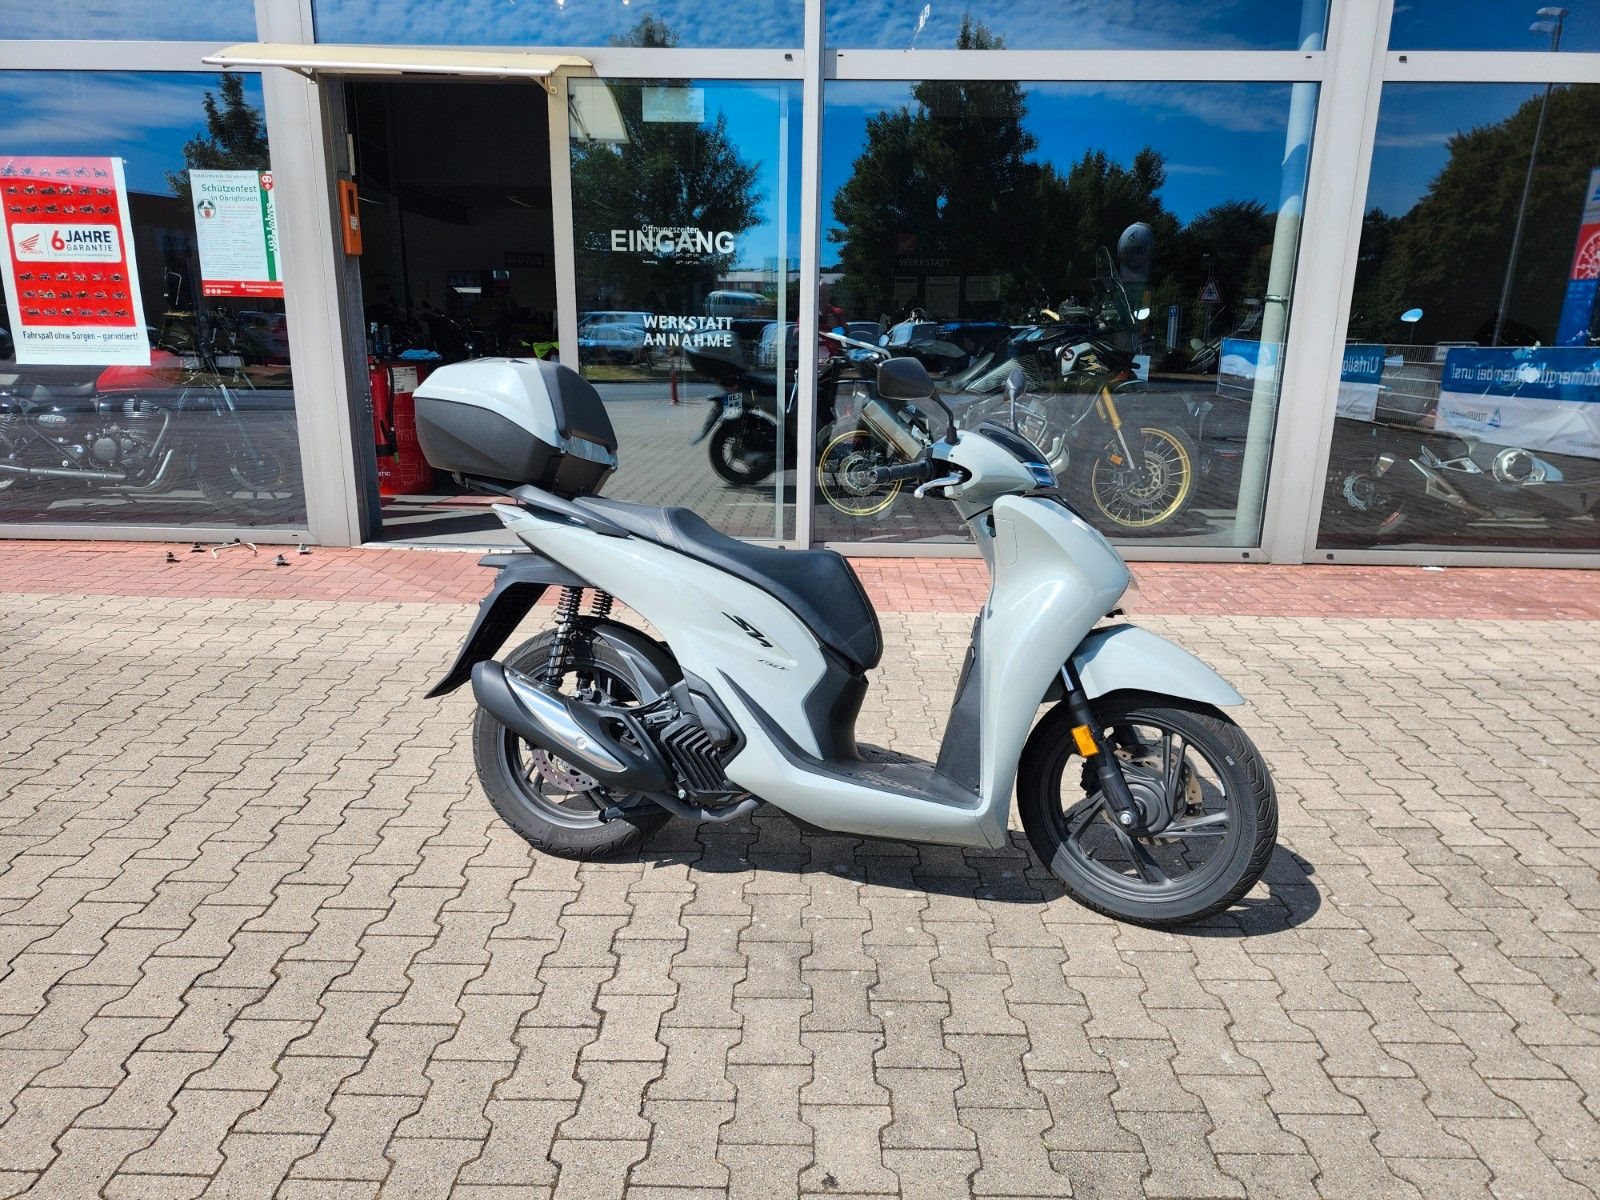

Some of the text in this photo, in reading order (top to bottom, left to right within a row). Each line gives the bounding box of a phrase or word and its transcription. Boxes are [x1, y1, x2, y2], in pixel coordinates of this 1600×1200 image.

[201, 183, 257, 193] Schützenfest
[265, 202, 276, 230] Jahre
[51, 229, 112, 251] 6 JAHRE
[611, 229, 735, 254] EINGANG
[66, 244, 113, 252] GARANTIE
[899, 257, 952, 267] WERKSTATT
[642, 314, 733, 330] WERKSTATT
[22, 331, 54, 341] Fahrspaß
[55, 331, 71, 340] ohne
[71, 331, 96, 342] Sorgen
[102, 332, 139, 342] garantiert!
[643, 333, 732, 348] ANNAHME
